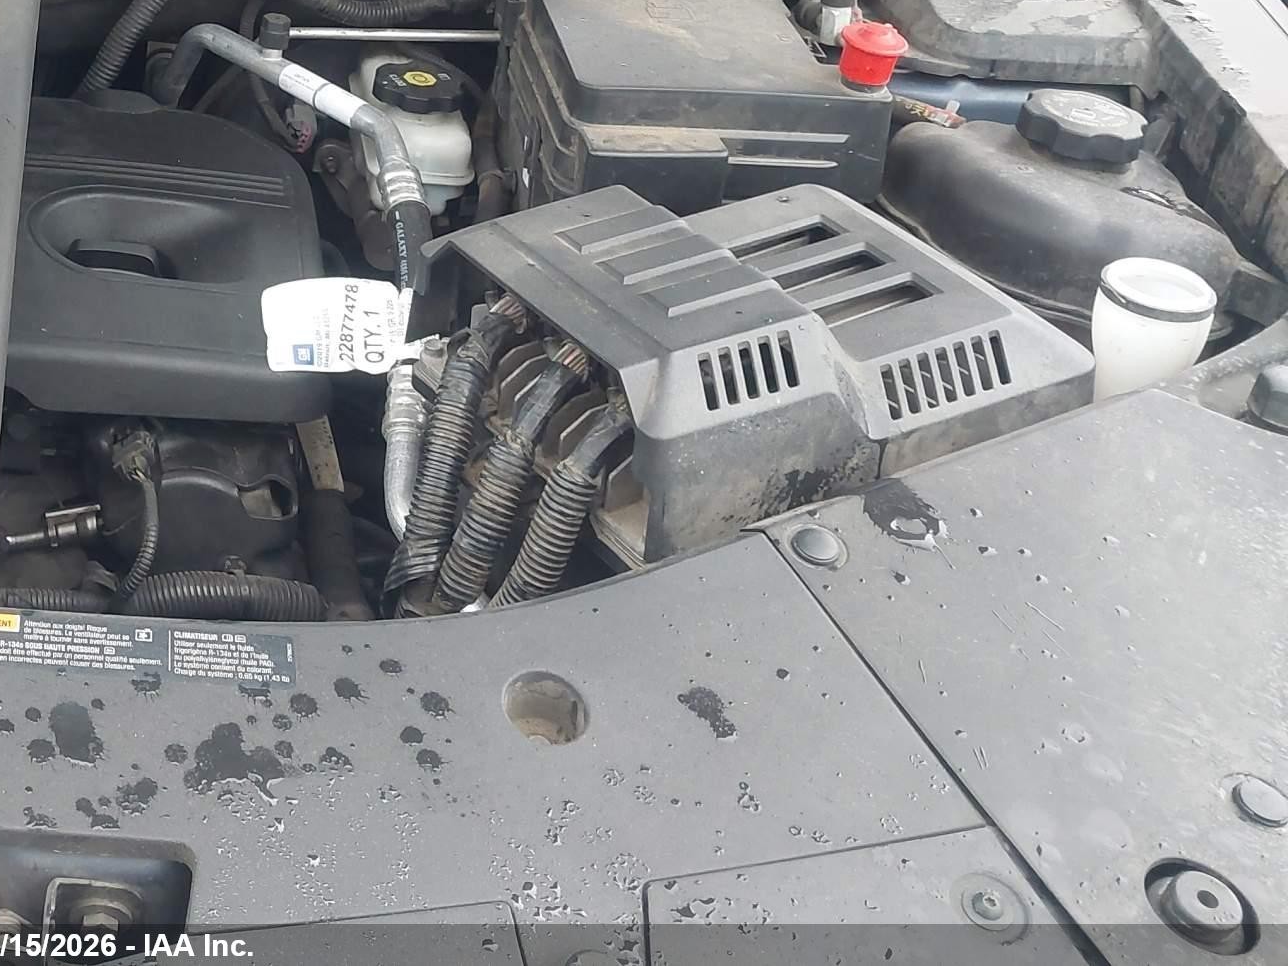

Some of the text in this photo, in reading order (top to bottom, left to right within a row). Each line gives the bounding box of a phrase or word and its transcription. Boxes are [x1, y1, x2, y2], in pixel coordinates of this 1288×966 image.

[395, 222, 407, 257] GALAXY
[339, 284, 359, 362] 22877478
[364, 310, 385, 363] QTY. 1
[174, 631, 218, 640] CLIMATISEUR
